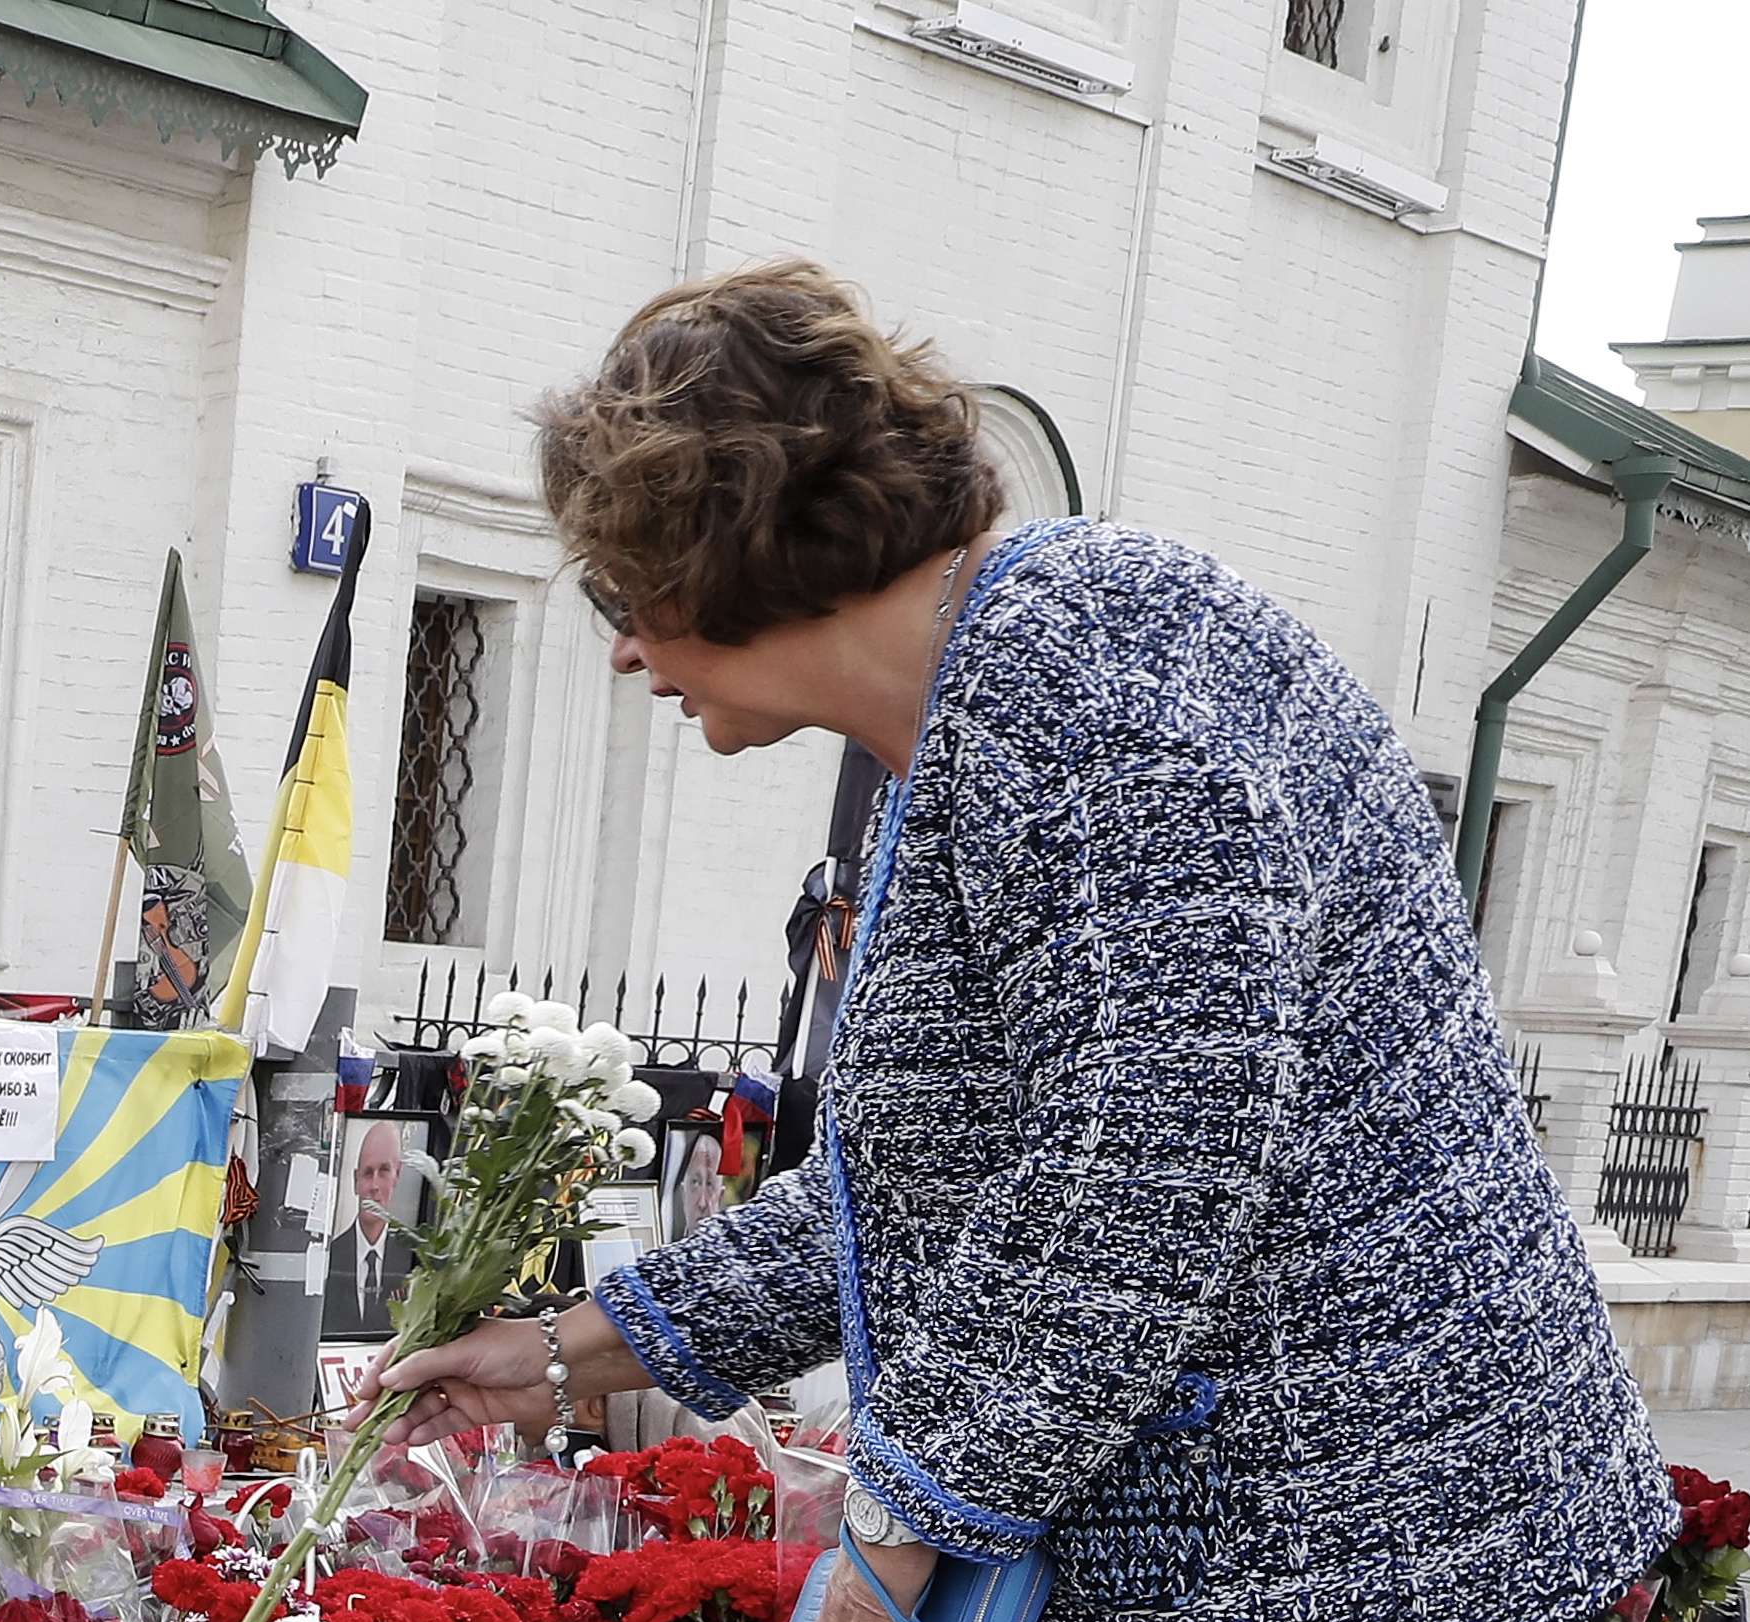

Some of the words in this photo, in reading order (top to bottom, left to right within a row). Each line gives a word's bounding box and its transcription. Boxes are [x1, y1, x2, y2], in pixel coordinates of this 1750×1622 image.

[321, 504, 346, 556] 4
[4, 1051, 52, 1066] СКОРБИТ
[24, 1082, 37, 1097] ЗА
[20, 1492, 48, 1504] OVER
[51, 1495, 74, 1508] TIME
[123, 1506, 148, 1518] OVER
[150, 1509, 169, 1522] TIME
